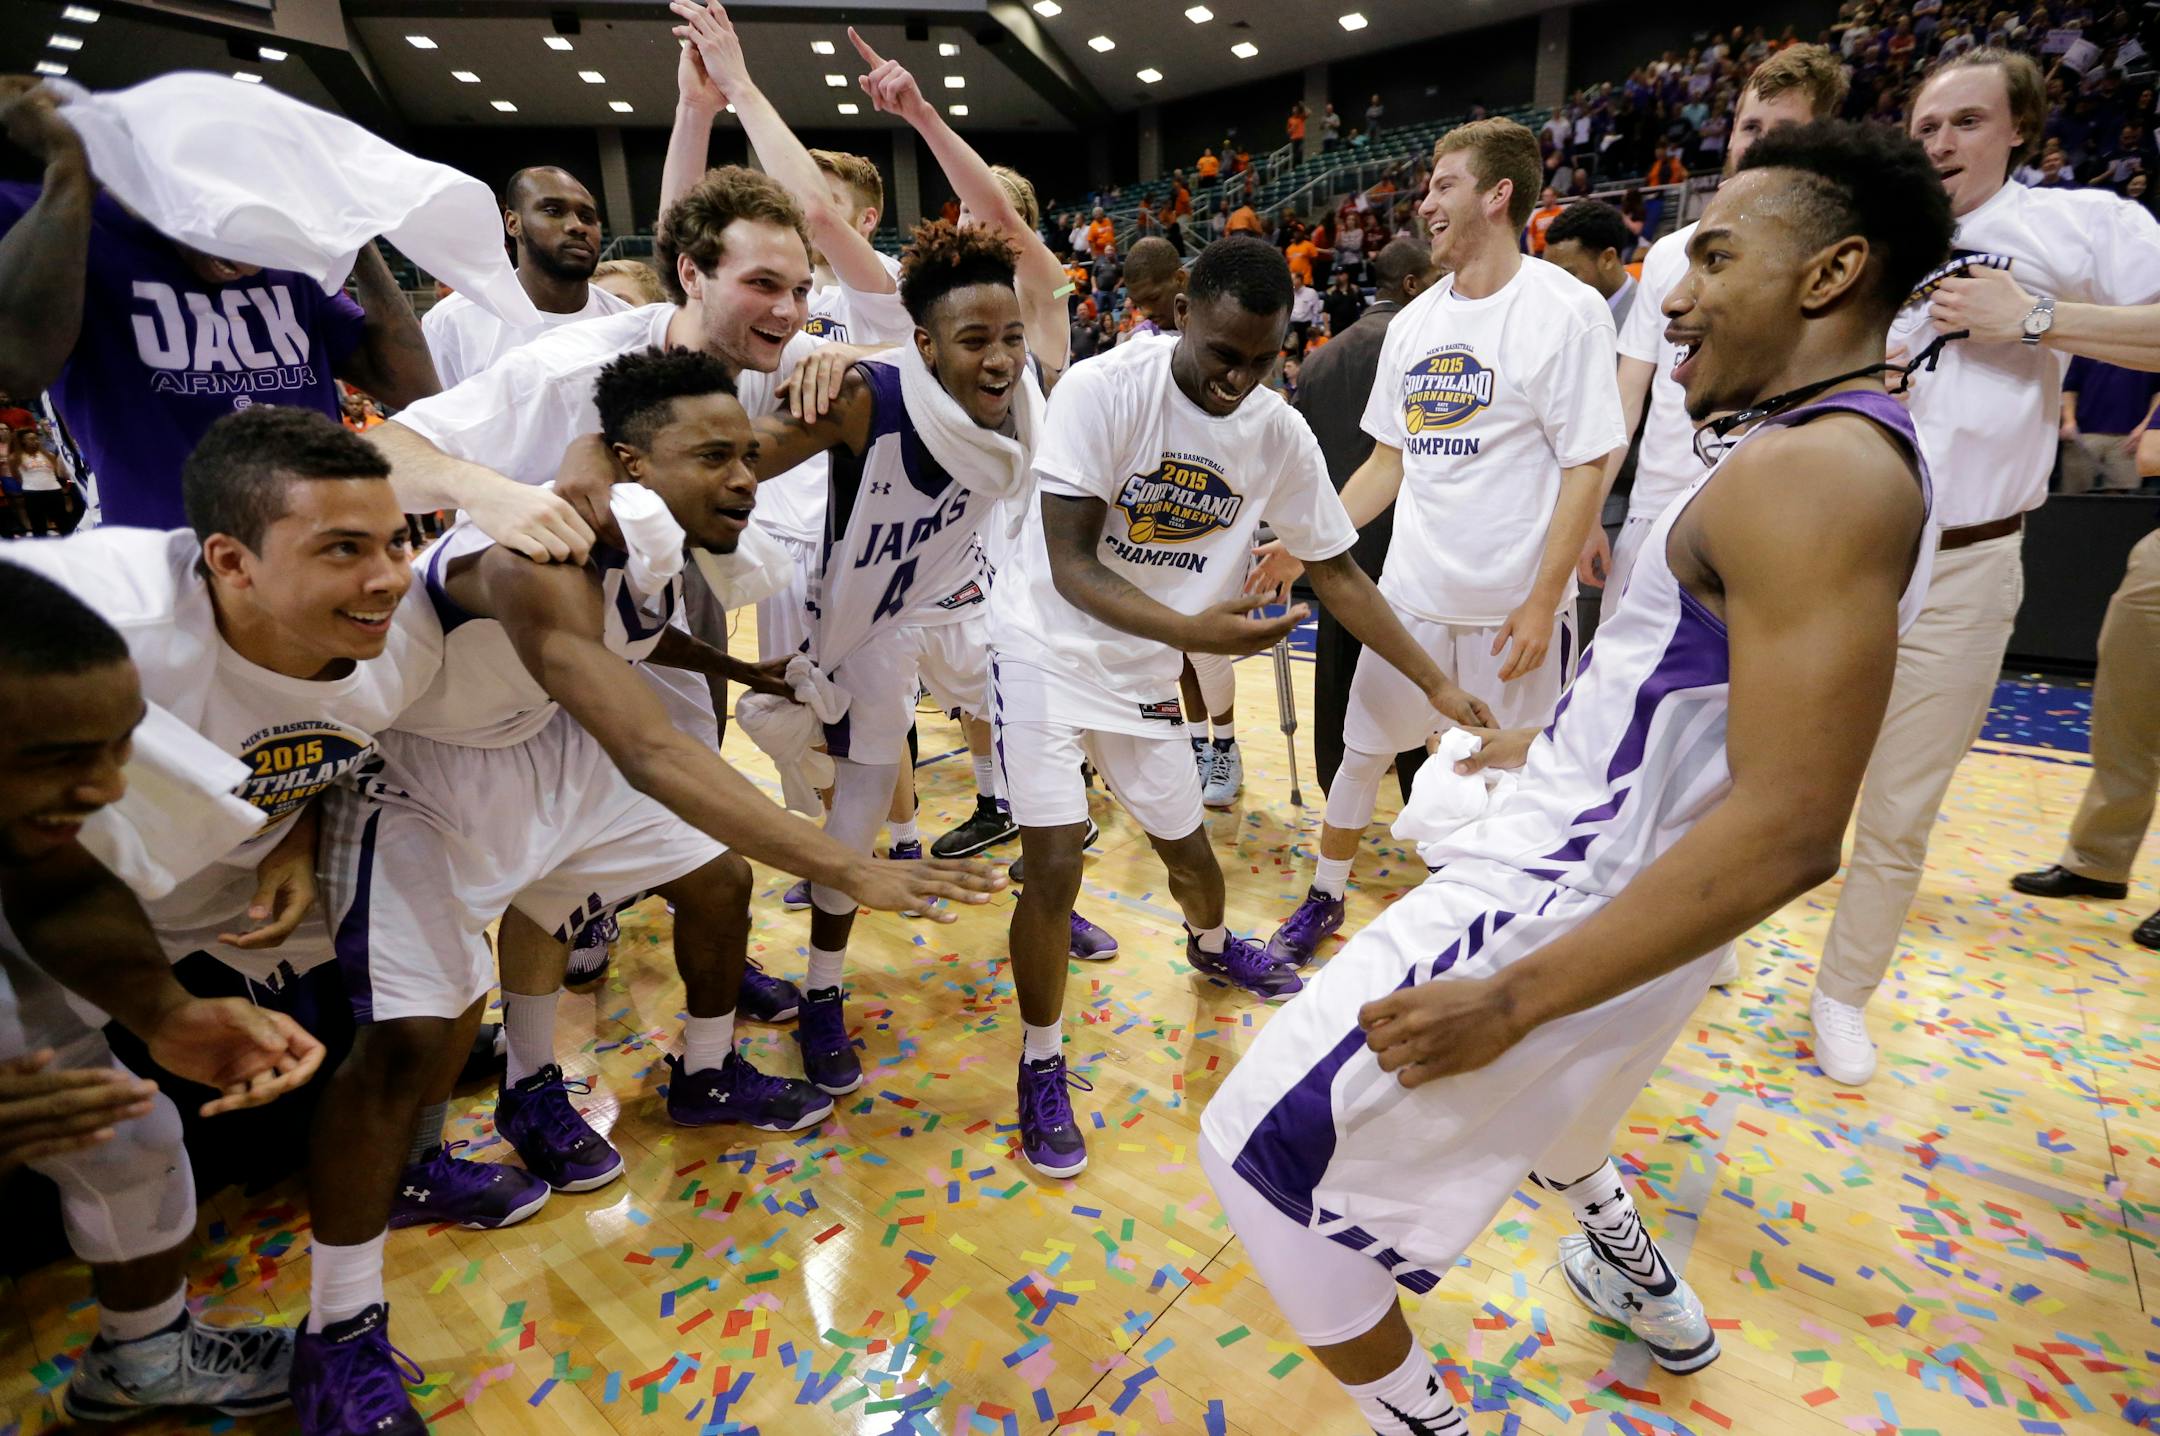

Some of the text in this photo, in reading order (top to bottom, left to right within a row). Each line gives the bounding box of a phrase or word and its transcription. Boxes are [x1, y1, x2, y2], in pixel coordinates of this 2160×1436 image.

[131, 281, 310, 371] JACK
[150, 364, 317, 394] ARMOUR
[1427, 356, 1464, 373] 2015
[1407, 390, 1475, 405] TOURNAMENT
[1405, 437, 1480, 455] HAMPION
[1162, 463, 1209, 491] 2015
[1183, 453, 1225, 475] BASKETBALL
[1118, 474, 1242, 527] SOUTHLAND
[1136, 501, 1217, 525] TOURNAMENT
[854, 488, 971, 569] JACKS
[872, 554, 919, 625] 4
[241, 721, 342, 750] MEN'S BASKETBALL
[255, 739, 324, 776] 2015
